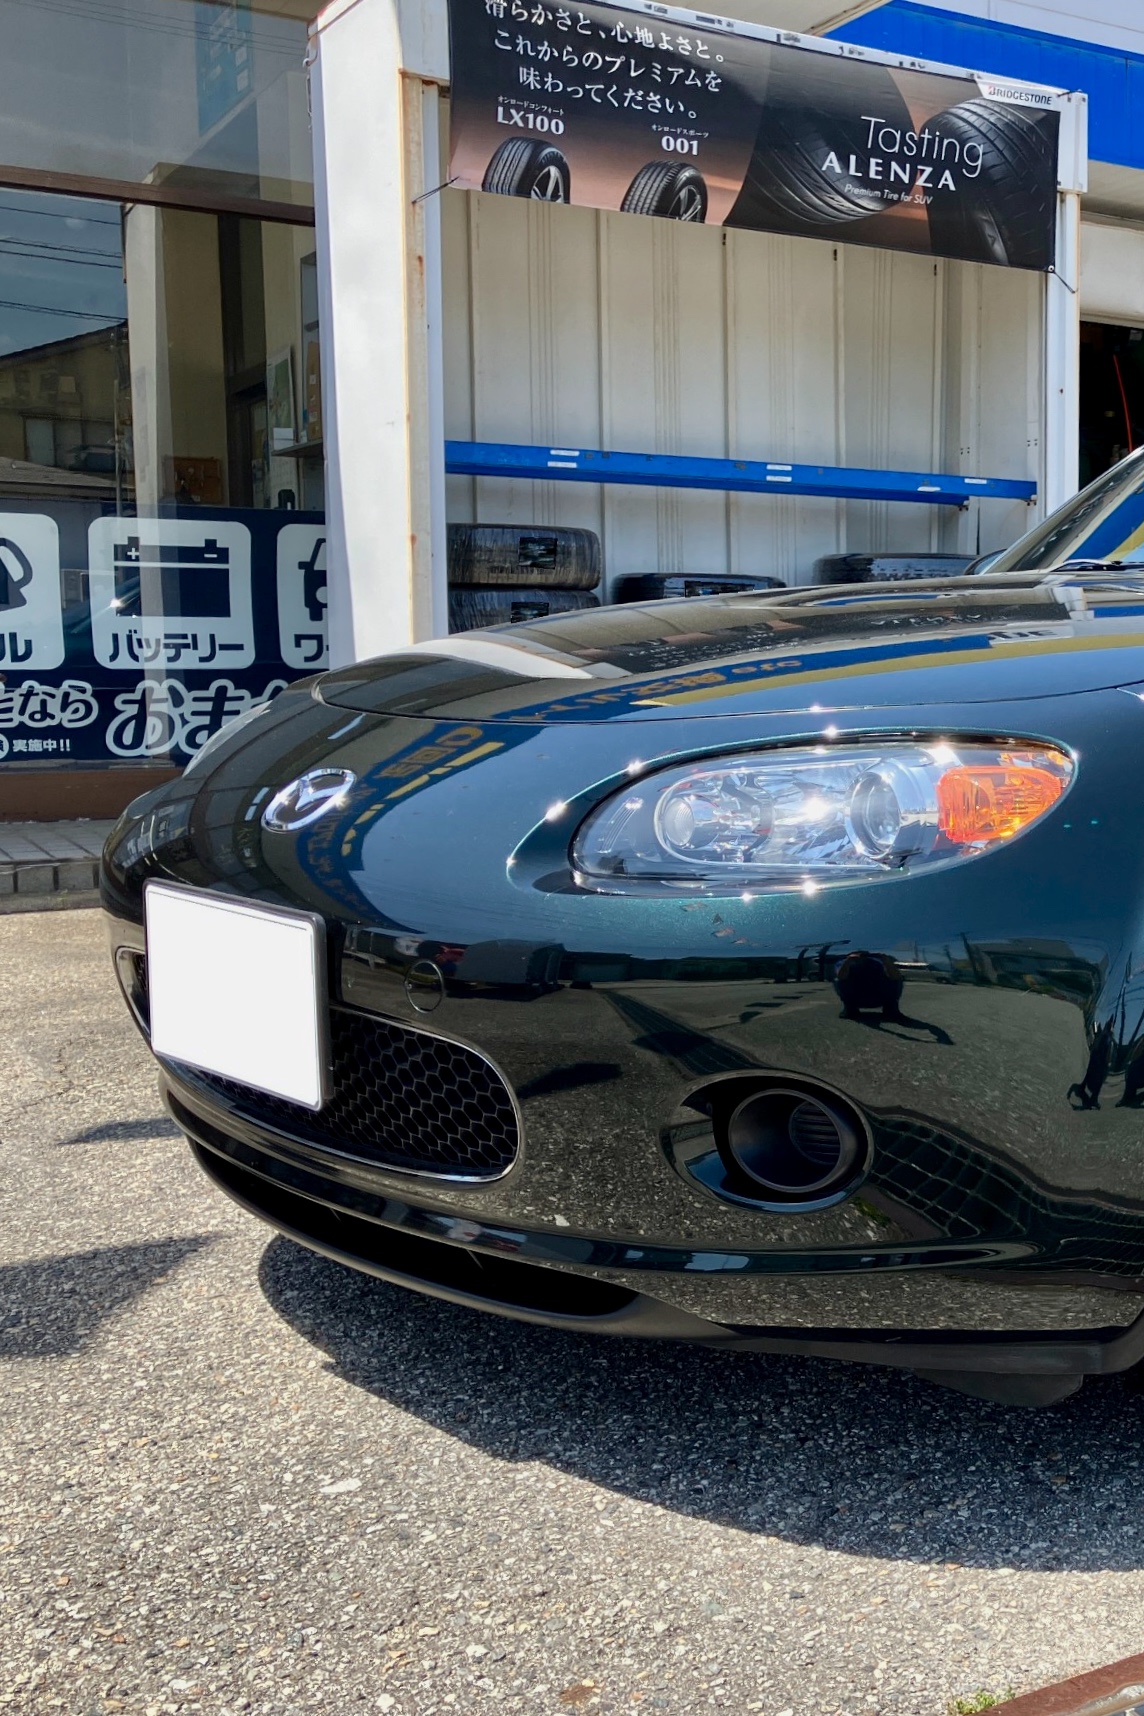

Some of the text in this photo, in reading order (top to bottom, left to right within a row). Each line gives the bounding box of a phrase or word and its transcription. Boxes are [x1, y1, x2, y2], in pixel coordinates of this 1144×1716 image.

[494, 29, 723, 92] これからのプレミアムを
[519, 66, 698, 119] 味わってください。
[988, 85, 1053, 106] BRIDGESTONE
[496, 106, 565, 135] LX100
[661, 136, 699, 156] 001
[861, 115, 984, 178] Tasting
[821, 151, 957, 192] ALENZA
[844, 183, 933, 205] Premium Tire for SUV
[0, 632, 33, 663] ル
[109, 629, 244, 663] バッテリー
[294, 634, 329, 663] ワ
[105, 679, 288, 757] おま
